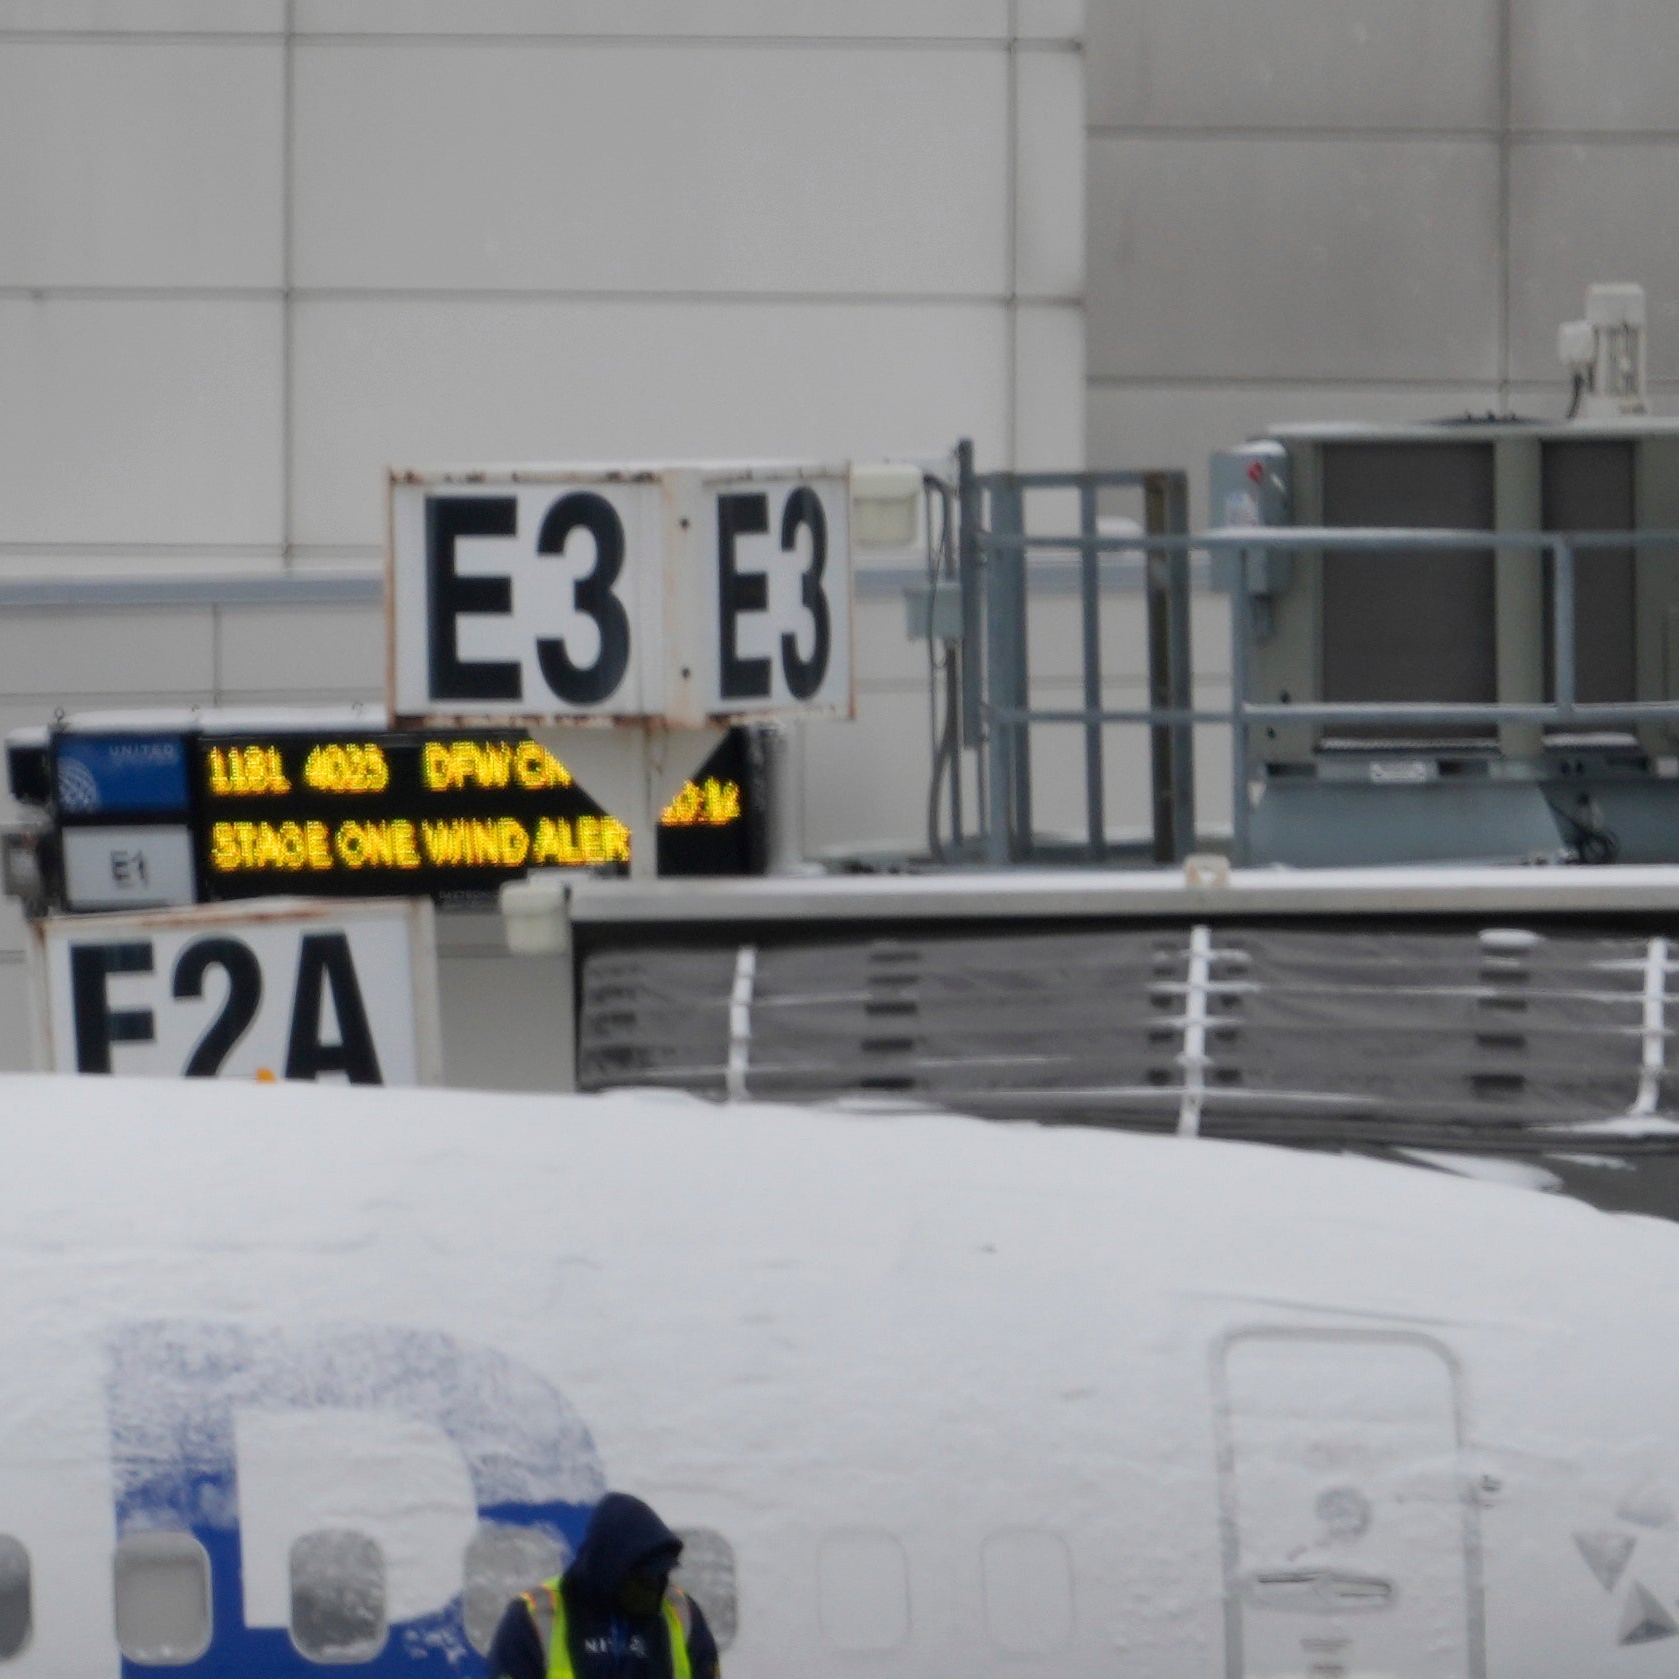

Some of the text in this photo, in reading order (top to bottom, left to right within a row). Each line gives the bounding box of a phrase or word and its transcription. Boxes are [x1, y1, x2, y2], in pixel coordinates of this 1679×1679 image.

[425, 490, 631, 706] E3
[716, 486, 832, 701] E3
[423, 740, 514, 791] DFW
[210, 815, 632, 872] STAGE ONE WIND ALER
